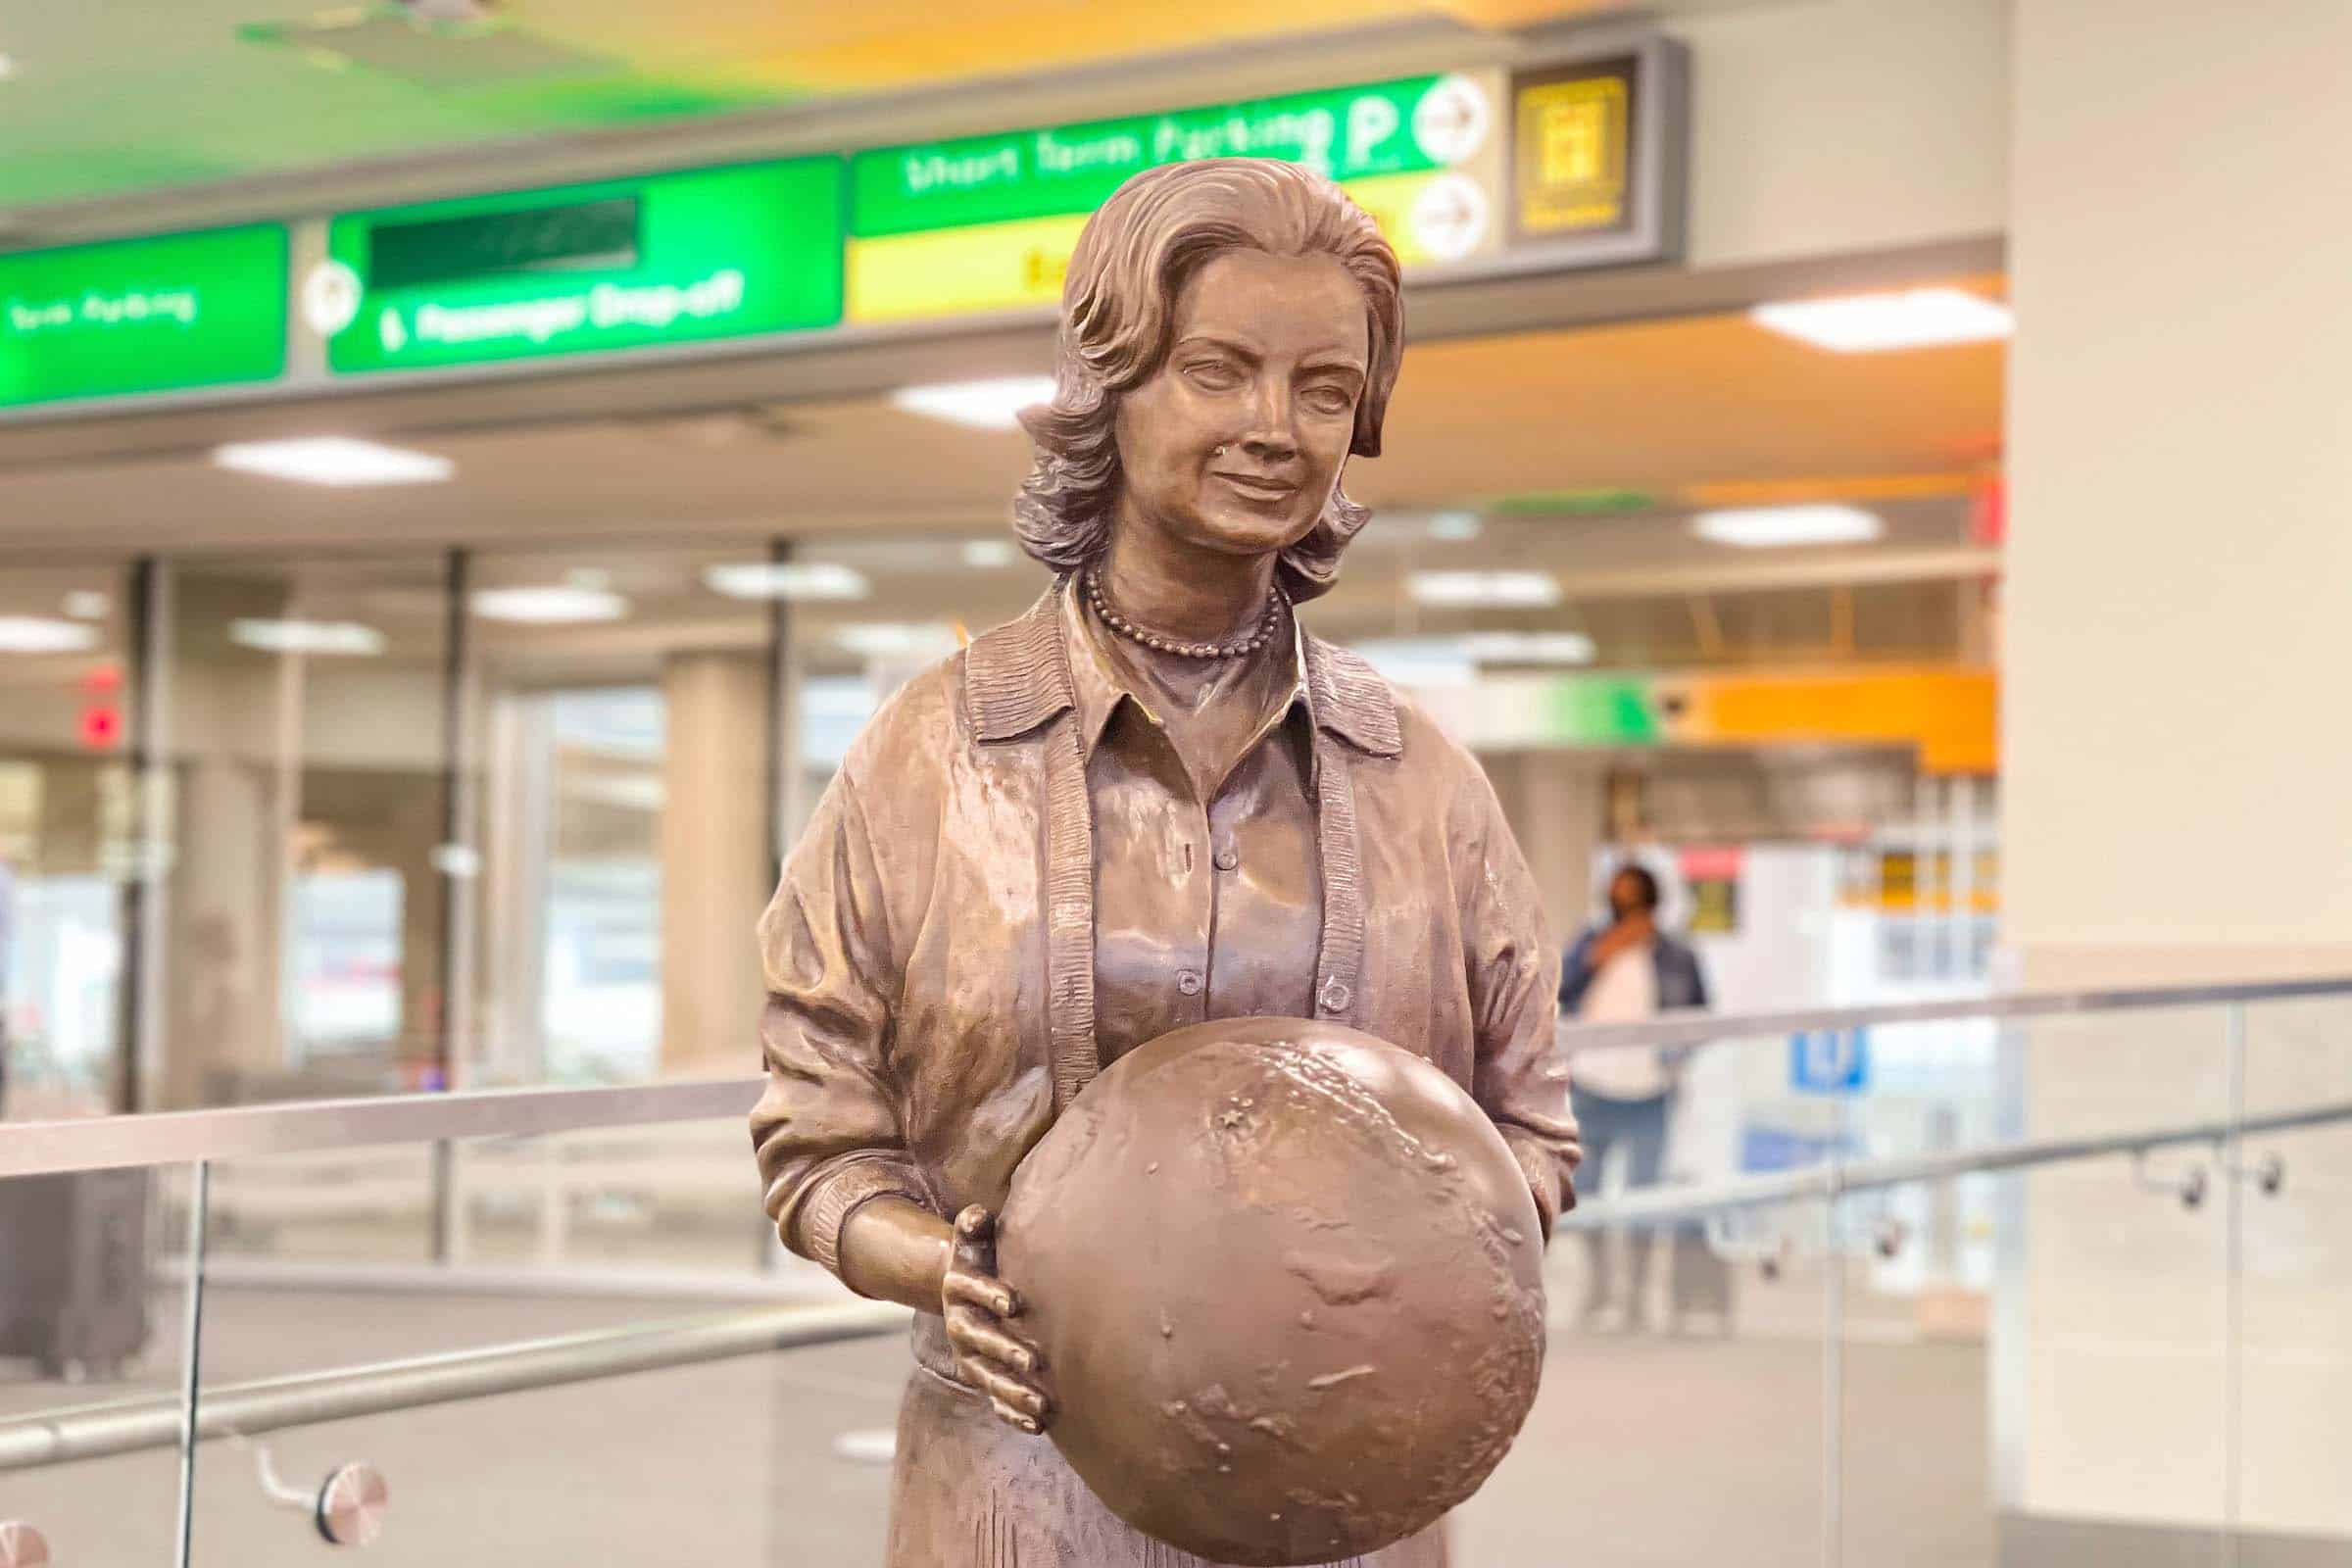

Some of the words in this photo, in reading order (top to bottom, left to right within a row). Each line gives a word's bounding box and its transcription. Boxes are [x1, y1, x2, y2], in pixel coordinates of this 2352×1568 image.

[906, 148, 1018, 191] Short
[1036, 131, 1139, 172] Term
[1153, 108, 1335, 180] Parking
[1347, 95, 1399, 169] P
